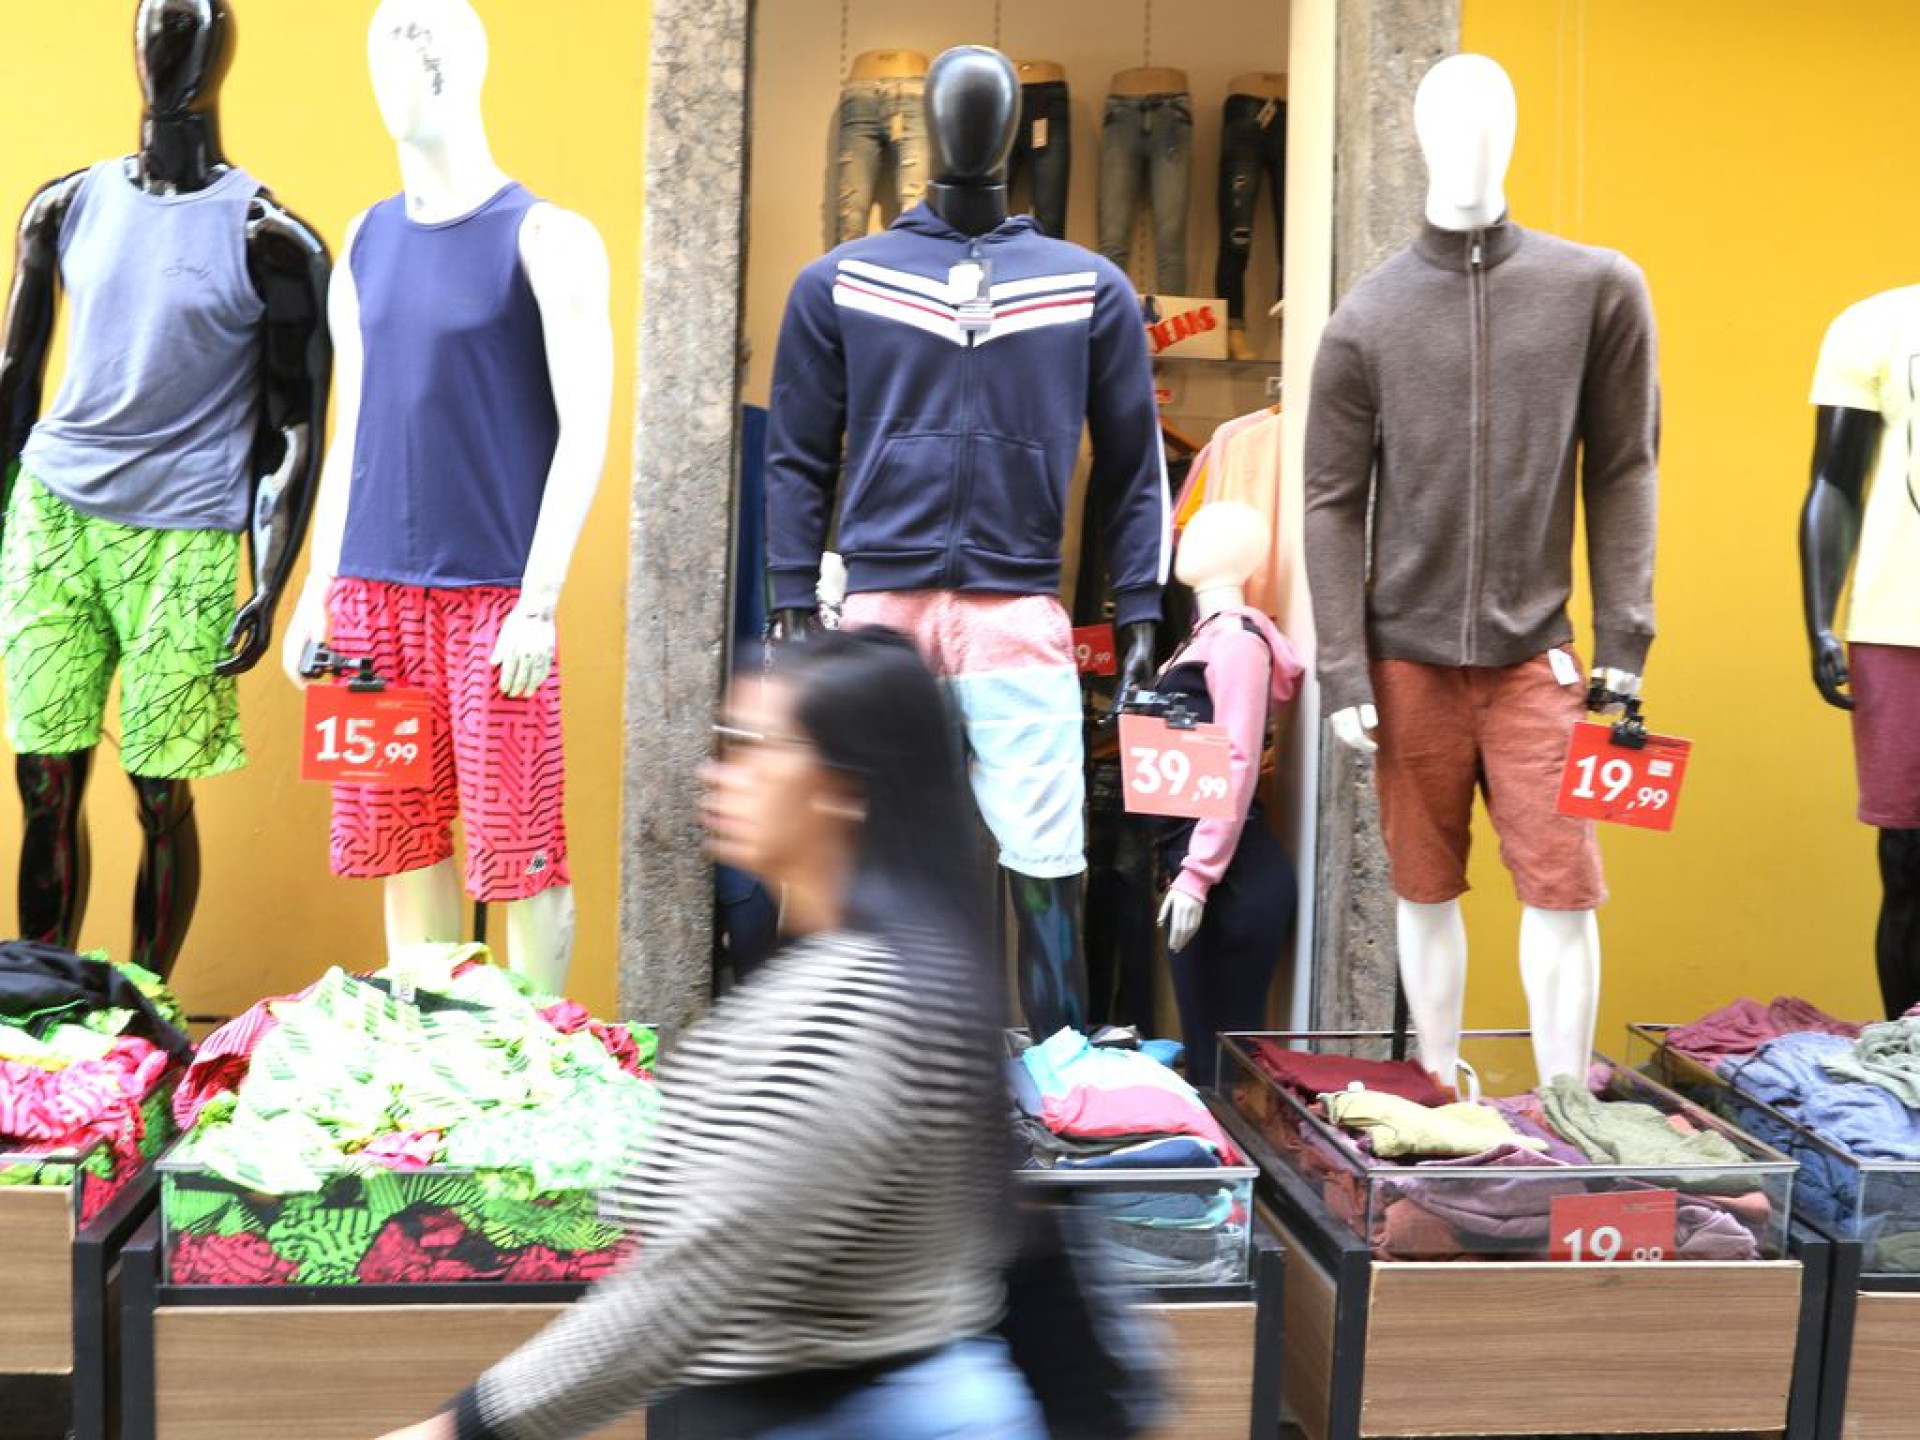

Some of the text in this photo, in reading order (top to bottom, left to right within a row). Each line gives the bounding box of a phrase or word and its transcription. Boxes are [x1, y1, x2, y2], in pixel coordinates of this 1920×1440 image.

[315, 716, 418, 768] 15,99
[1129, 747, 1227, 801] 39,99
[1572, 755, 1669, 810] 19,99
